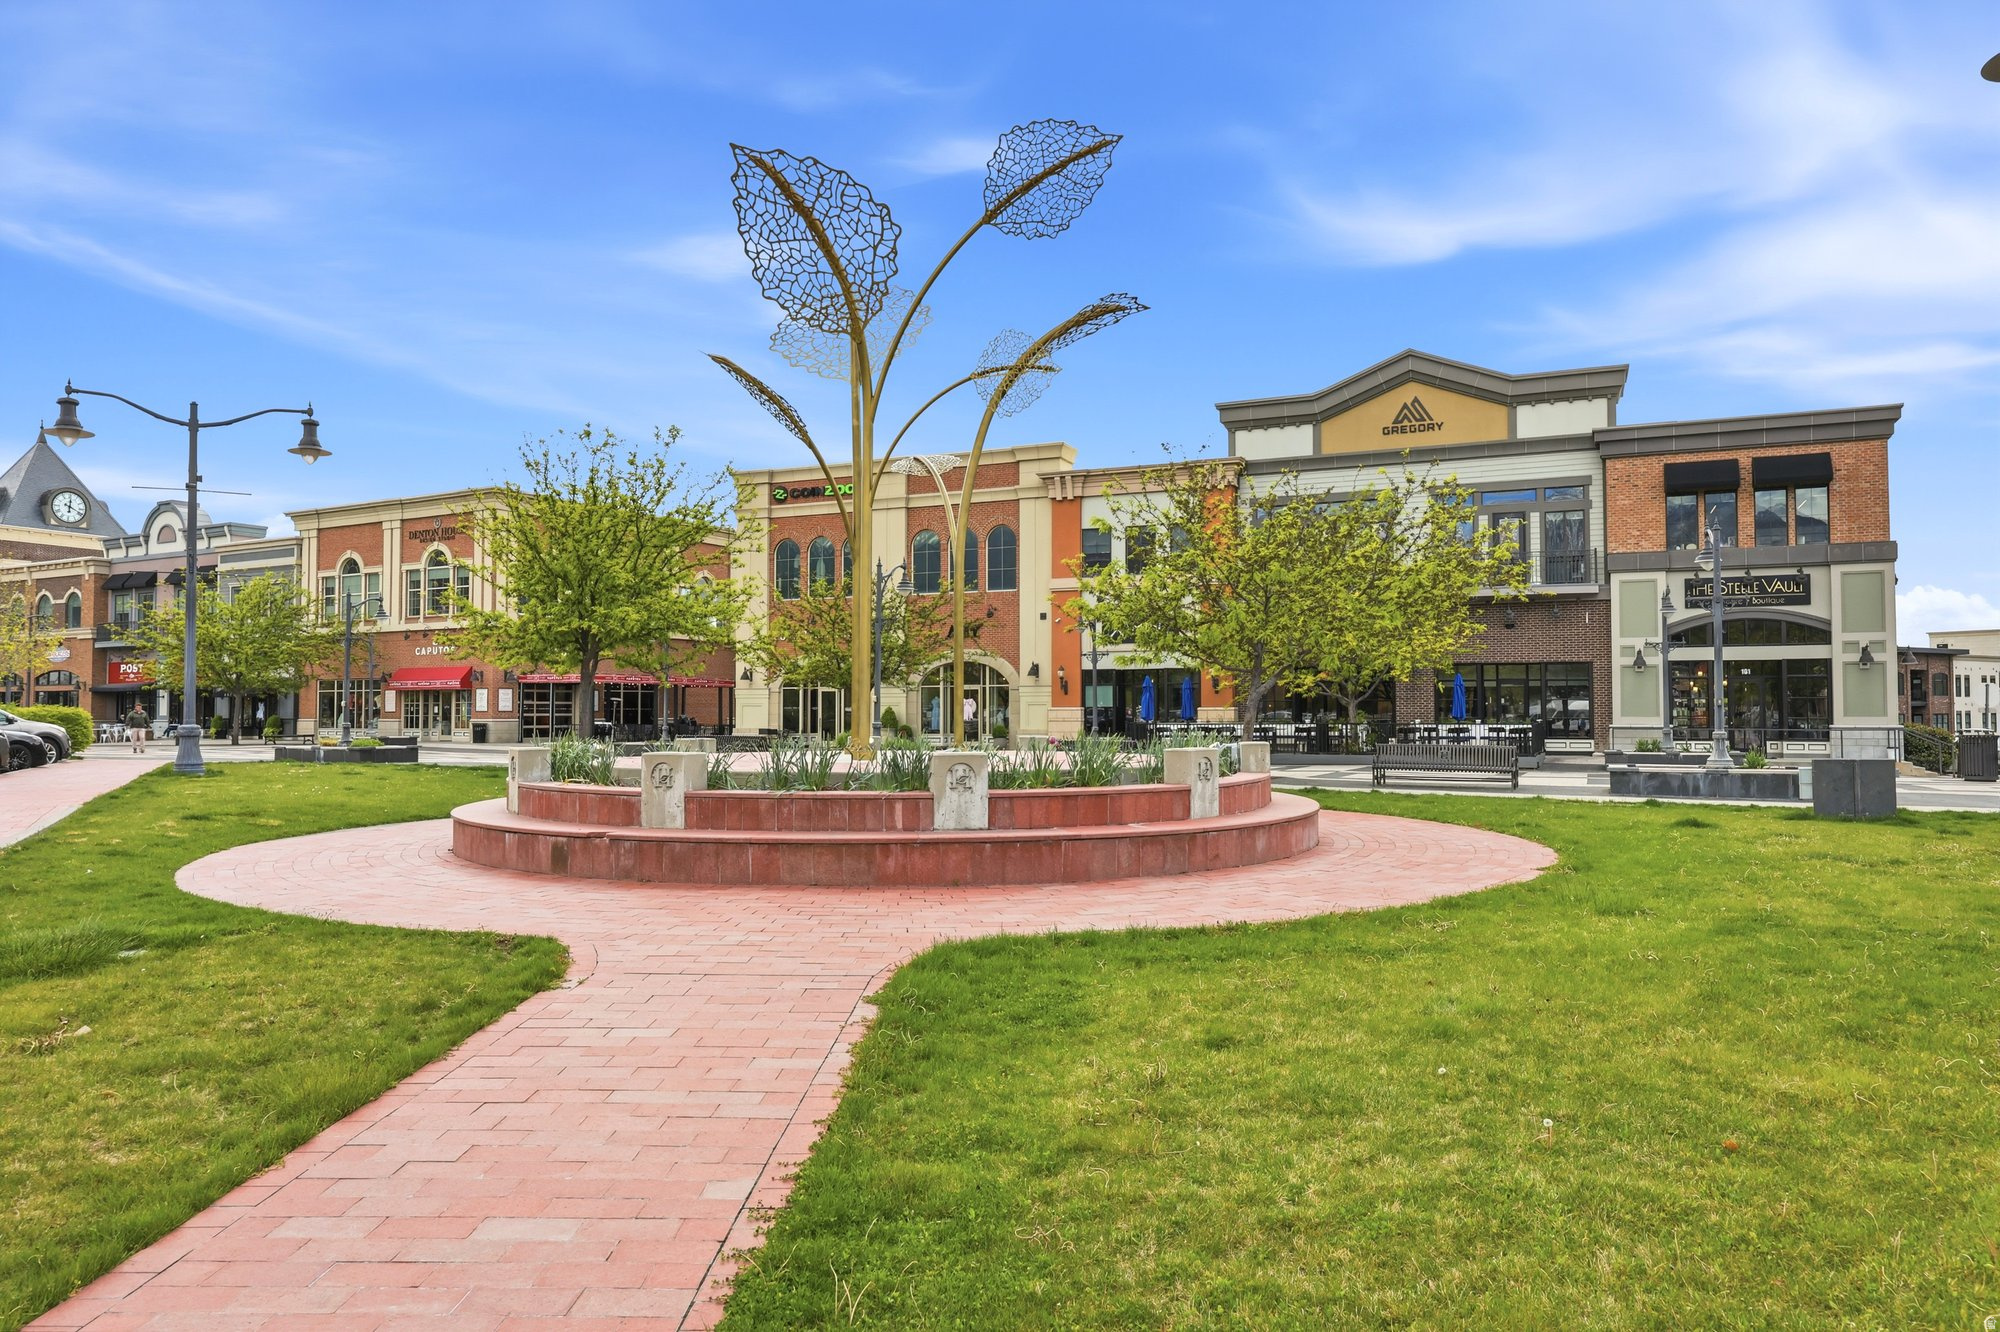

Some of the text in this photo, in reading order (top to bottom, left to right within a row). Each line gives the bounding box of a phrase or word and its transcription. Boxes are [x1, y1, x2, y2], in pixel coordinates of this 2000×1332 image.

[1382, 422, 1444, 436] GREGORY
[790, 484, 854, 498] COINZOO
[409, 528, 439, 540] DENTON
[120, 664, 144, 673] POST
